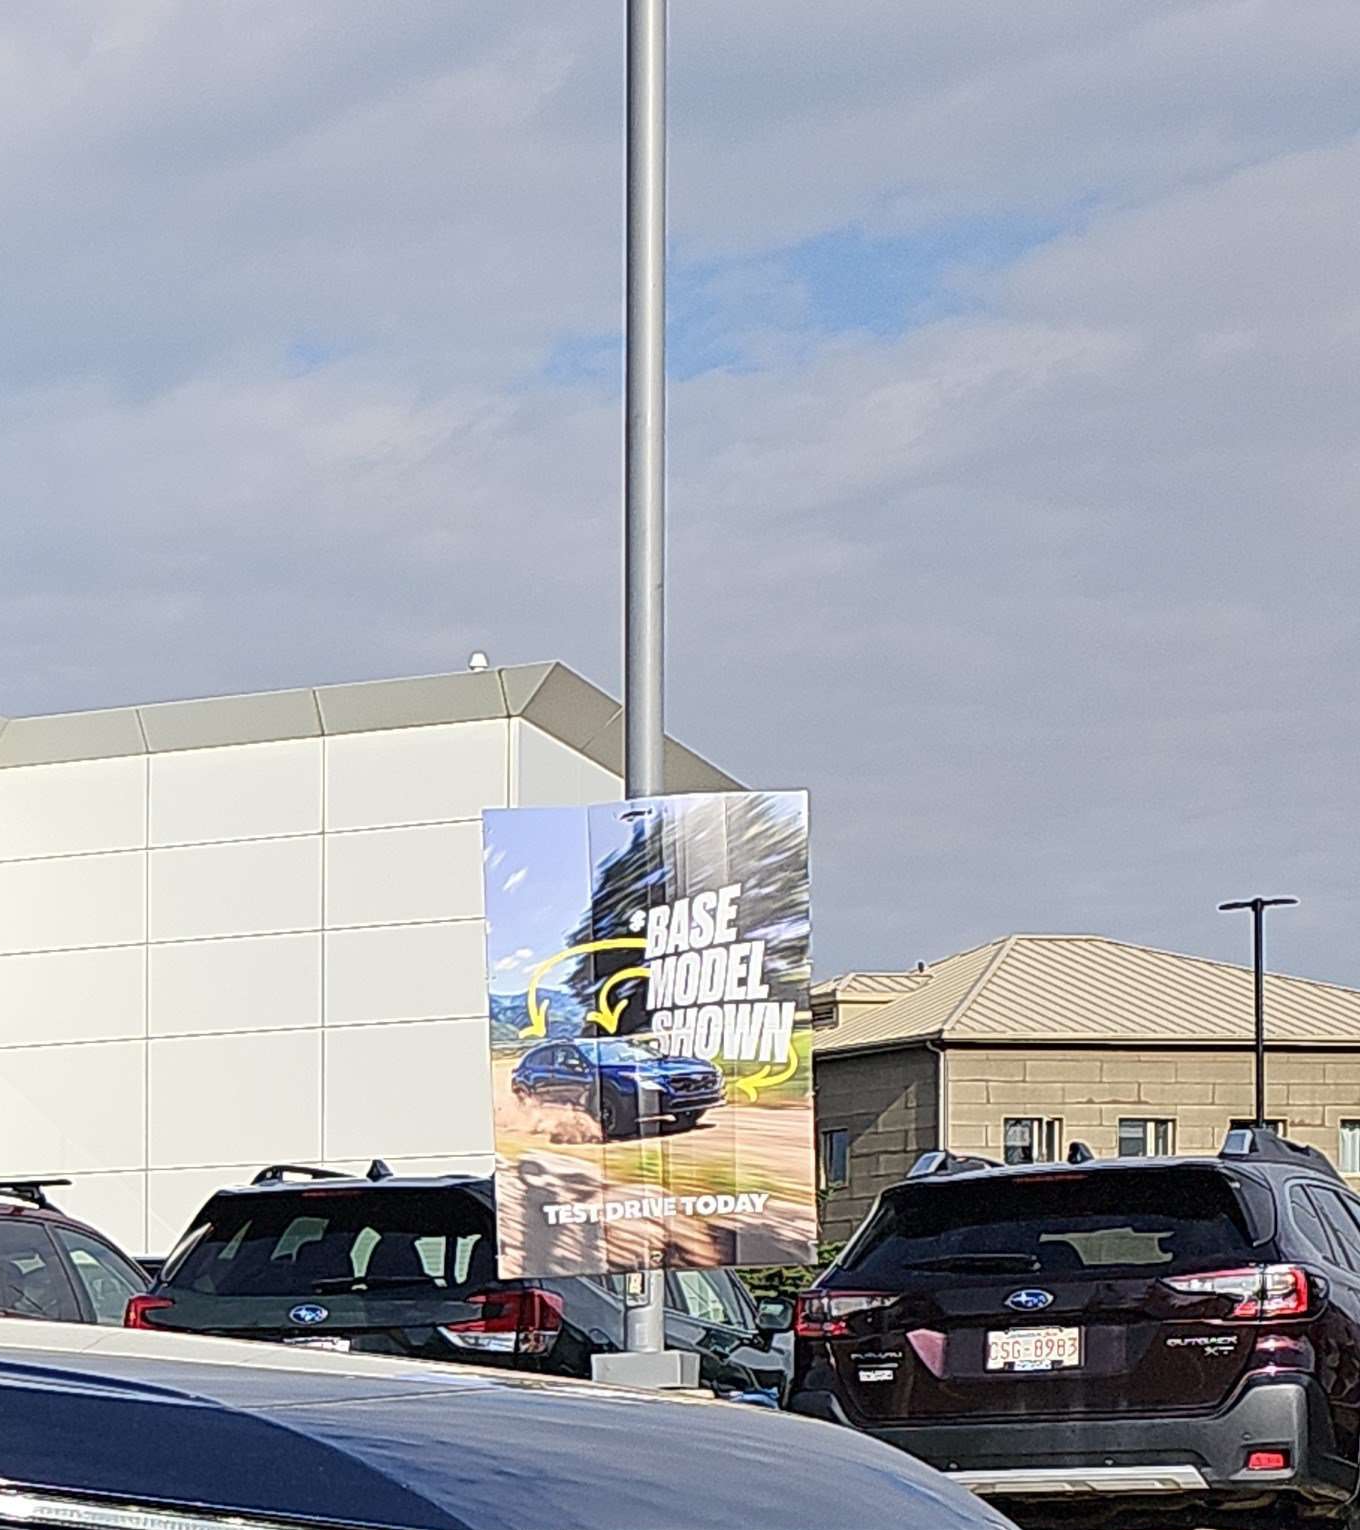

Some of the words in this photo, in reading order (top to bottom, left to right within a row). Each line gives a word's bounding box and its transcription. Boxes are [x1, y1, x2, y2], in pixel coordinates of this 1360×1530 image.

[645, 941, 770, 1012] MODEL
[650, 1001, 797, 1064] SHOWN
[542, 1203, 602, 1225] TEST
[606, 1197, 677, 1222] DRIVE
[679, 1193, 770, 1217] TODAY
